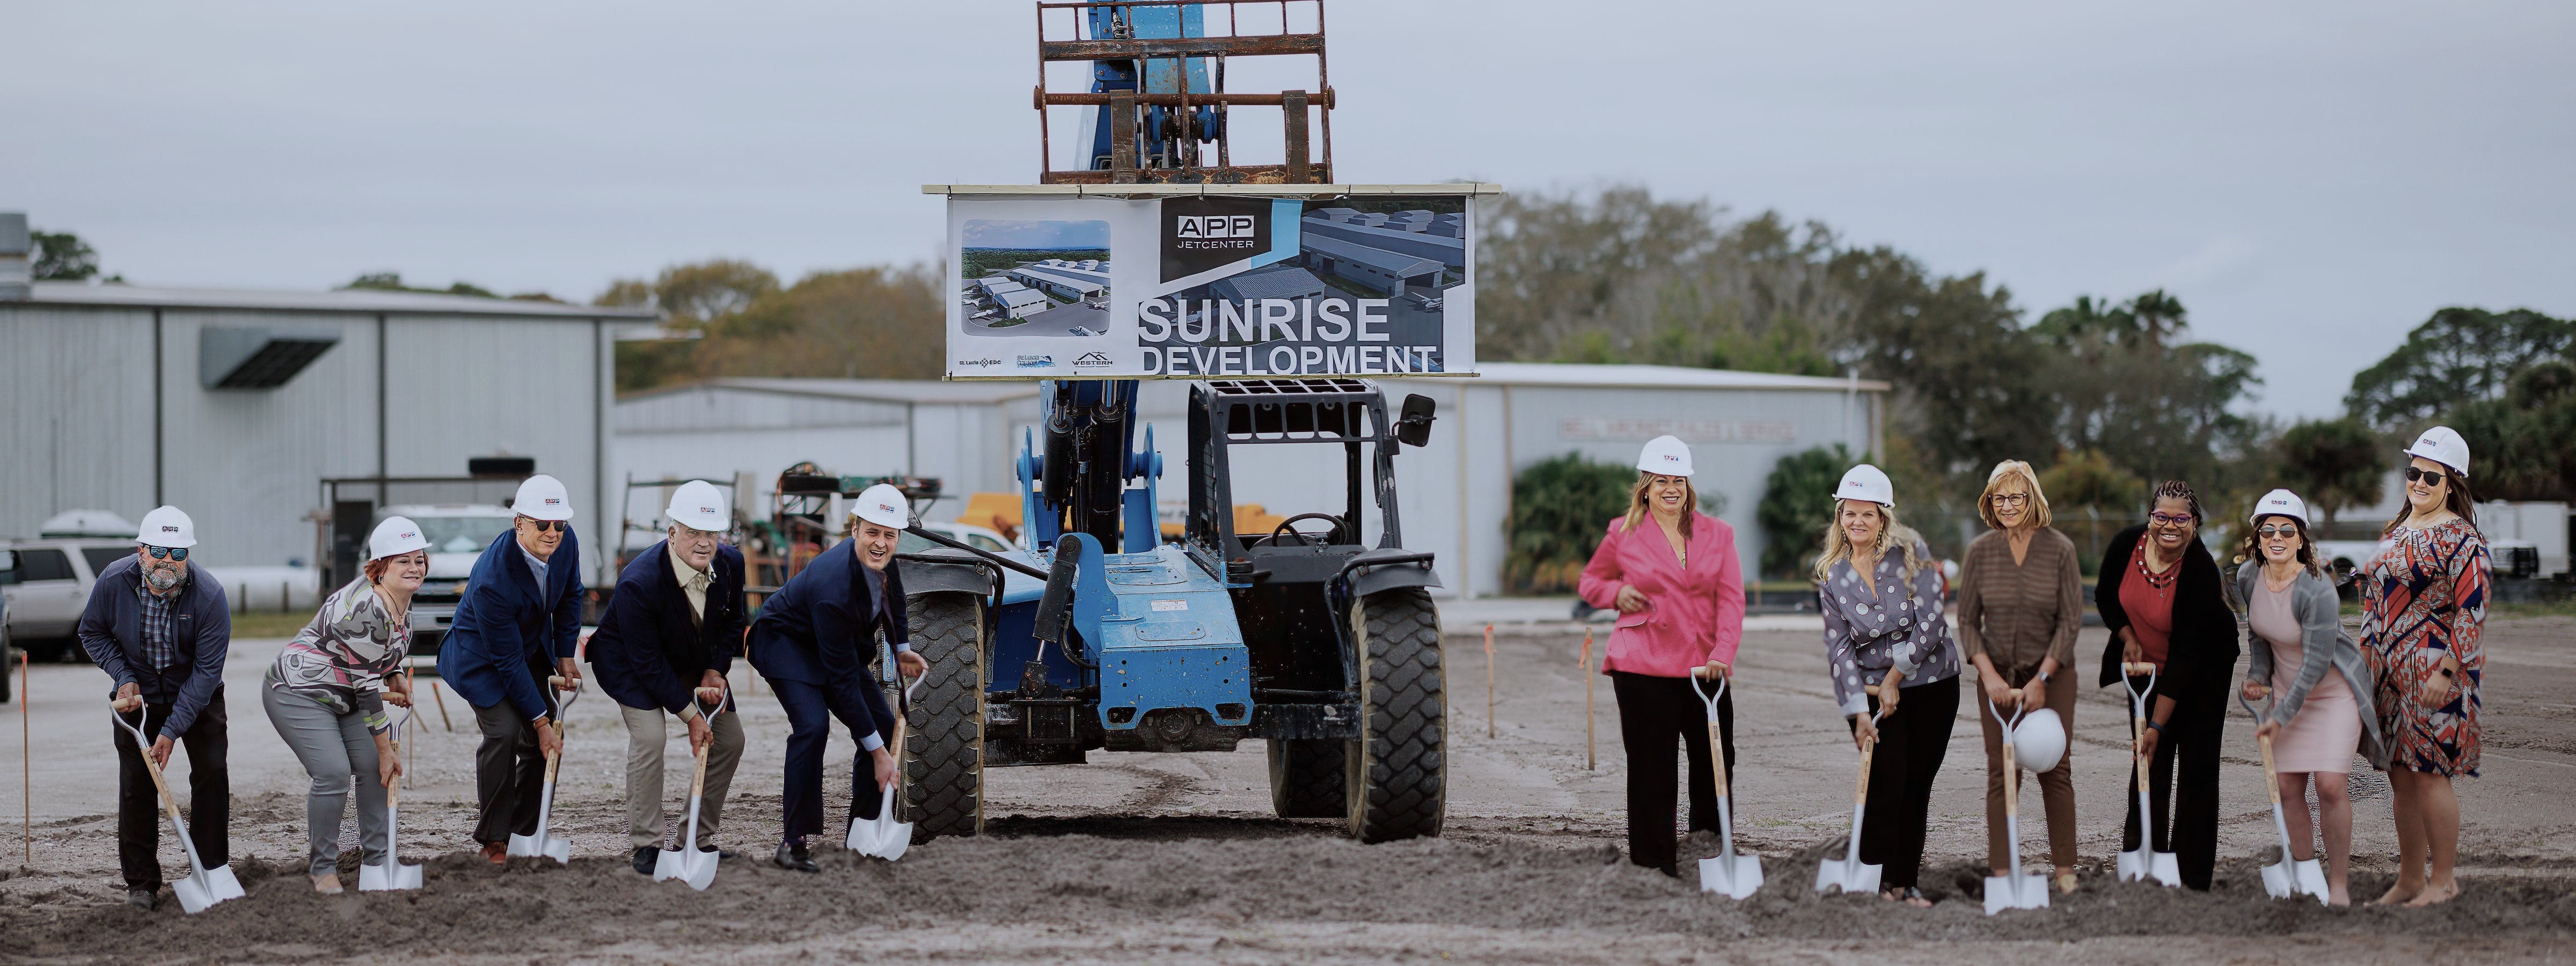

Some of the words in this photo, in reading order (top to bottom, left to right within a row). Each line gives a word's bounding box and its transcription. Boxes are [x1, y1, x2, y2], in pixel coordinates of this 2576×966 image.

[1179, 218, 1253, 236] APP
[1177, 240, 1254, 249] JETCENTER
[1138, 297, 1390, 342] SUNRISE
[1143, 346, 1437, 375] DEVELOPMENT
